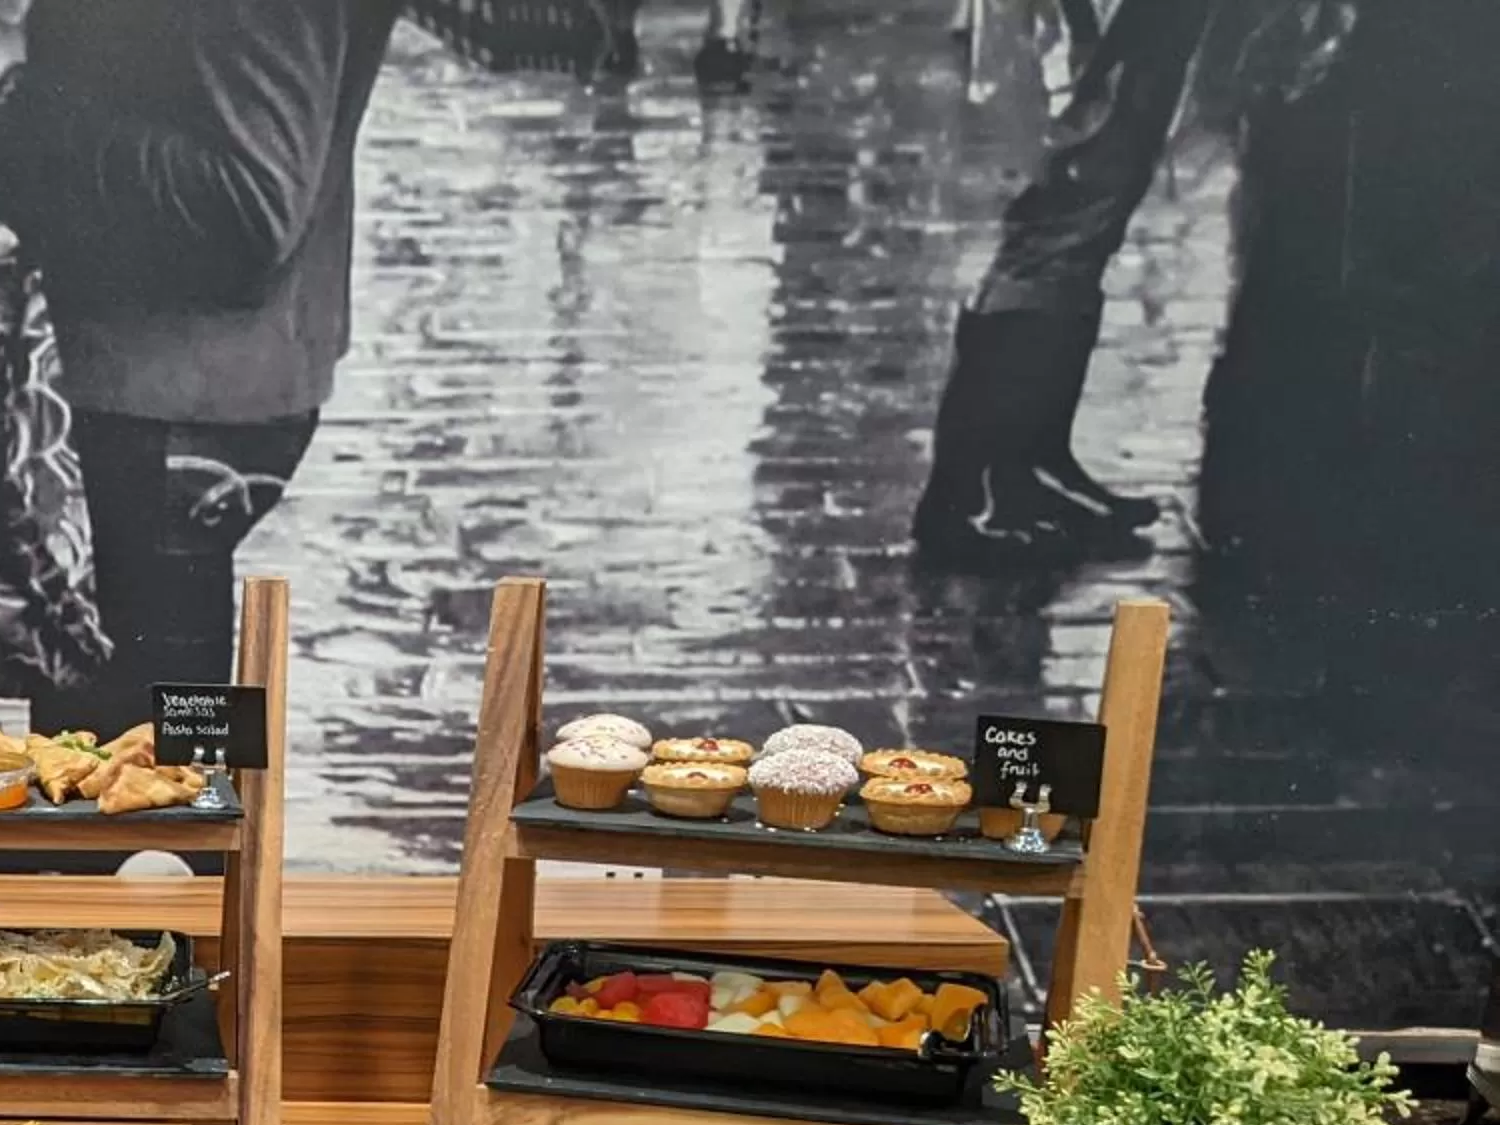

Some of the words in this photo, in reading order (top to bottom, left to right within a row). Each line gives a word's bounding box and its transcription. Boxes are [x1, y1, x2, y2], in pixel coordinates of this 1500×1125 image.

[985, 726, 1037, 745] Cakes
[997, 747, 1029, 761] and
[1000, 761, 1040, 780] fruit
